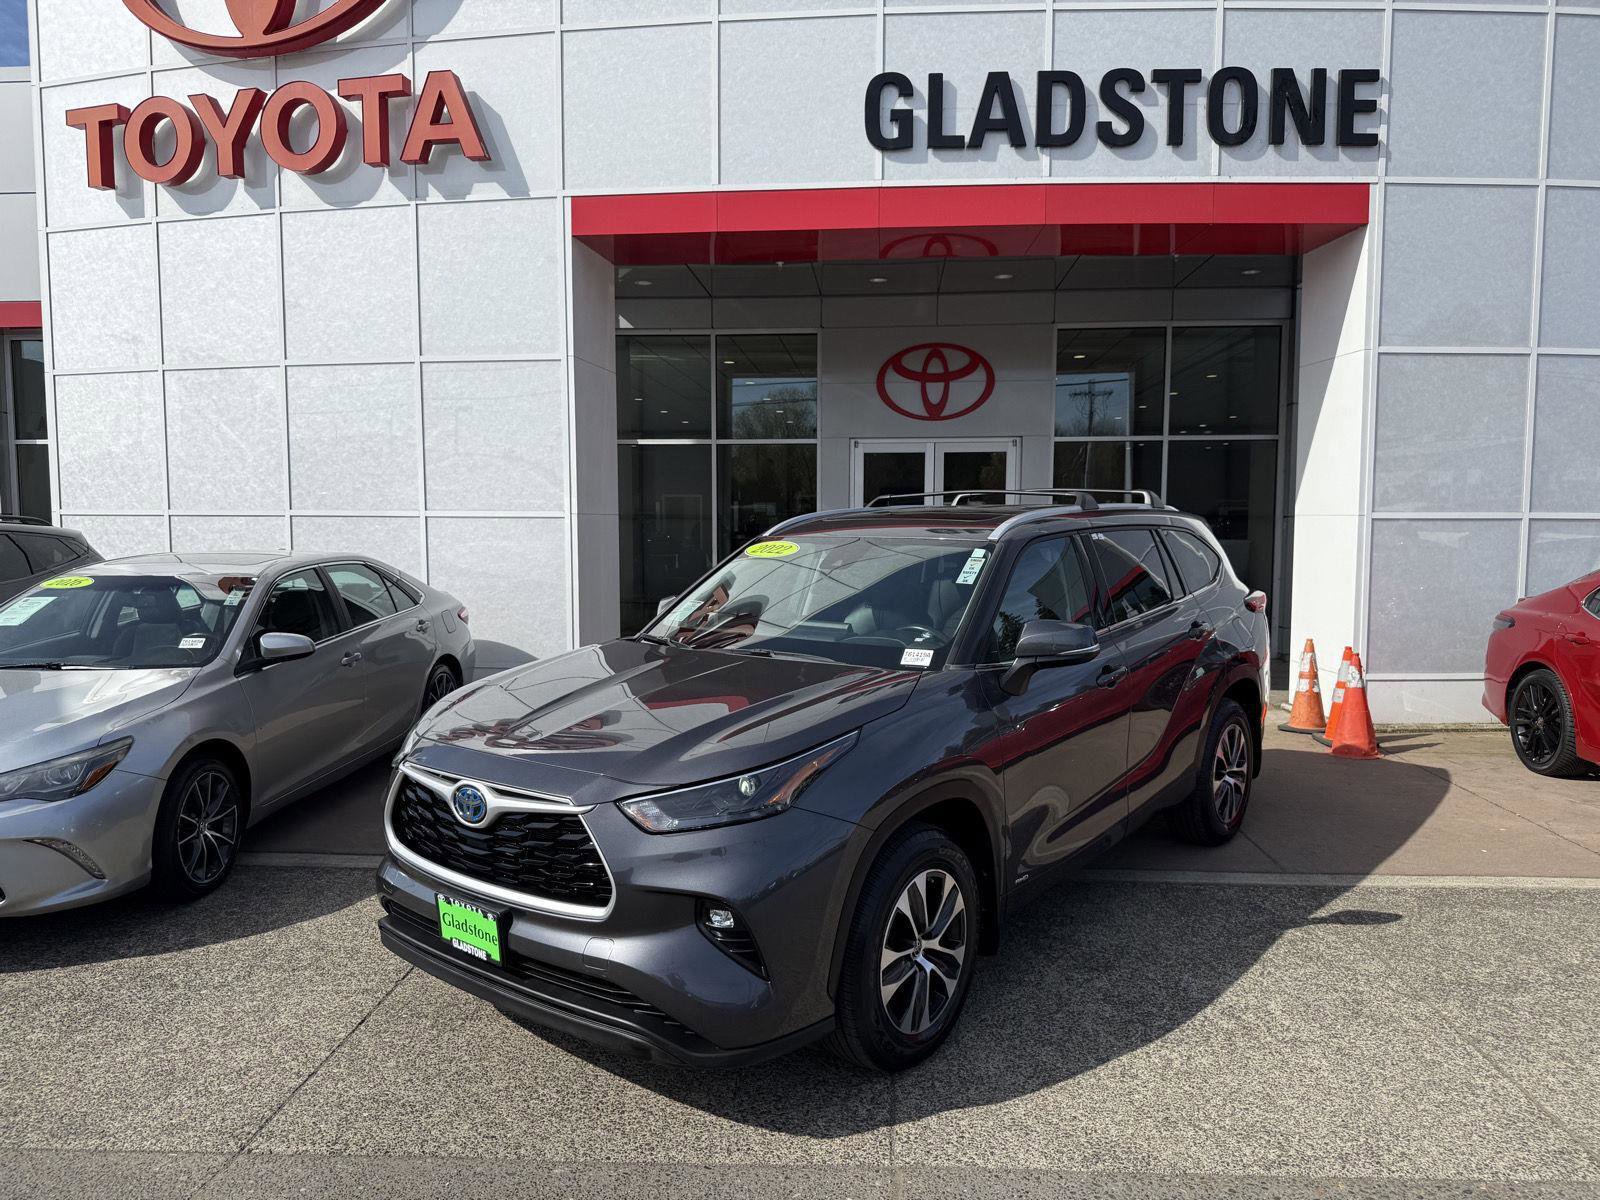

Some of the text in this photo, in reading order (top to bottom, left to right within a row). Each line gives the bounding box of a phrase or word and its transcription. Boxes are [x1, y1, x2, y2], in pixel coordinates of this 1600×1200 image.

[865, 66, 1380, 150] GLADSTONE
[65, 69, 491, 191] TOYOTA
[449, 897, 484, 916] TOYOTA
[442, 912, 498, 946] Gladstone
[452, 938, 488, 961] GLADSTONE
